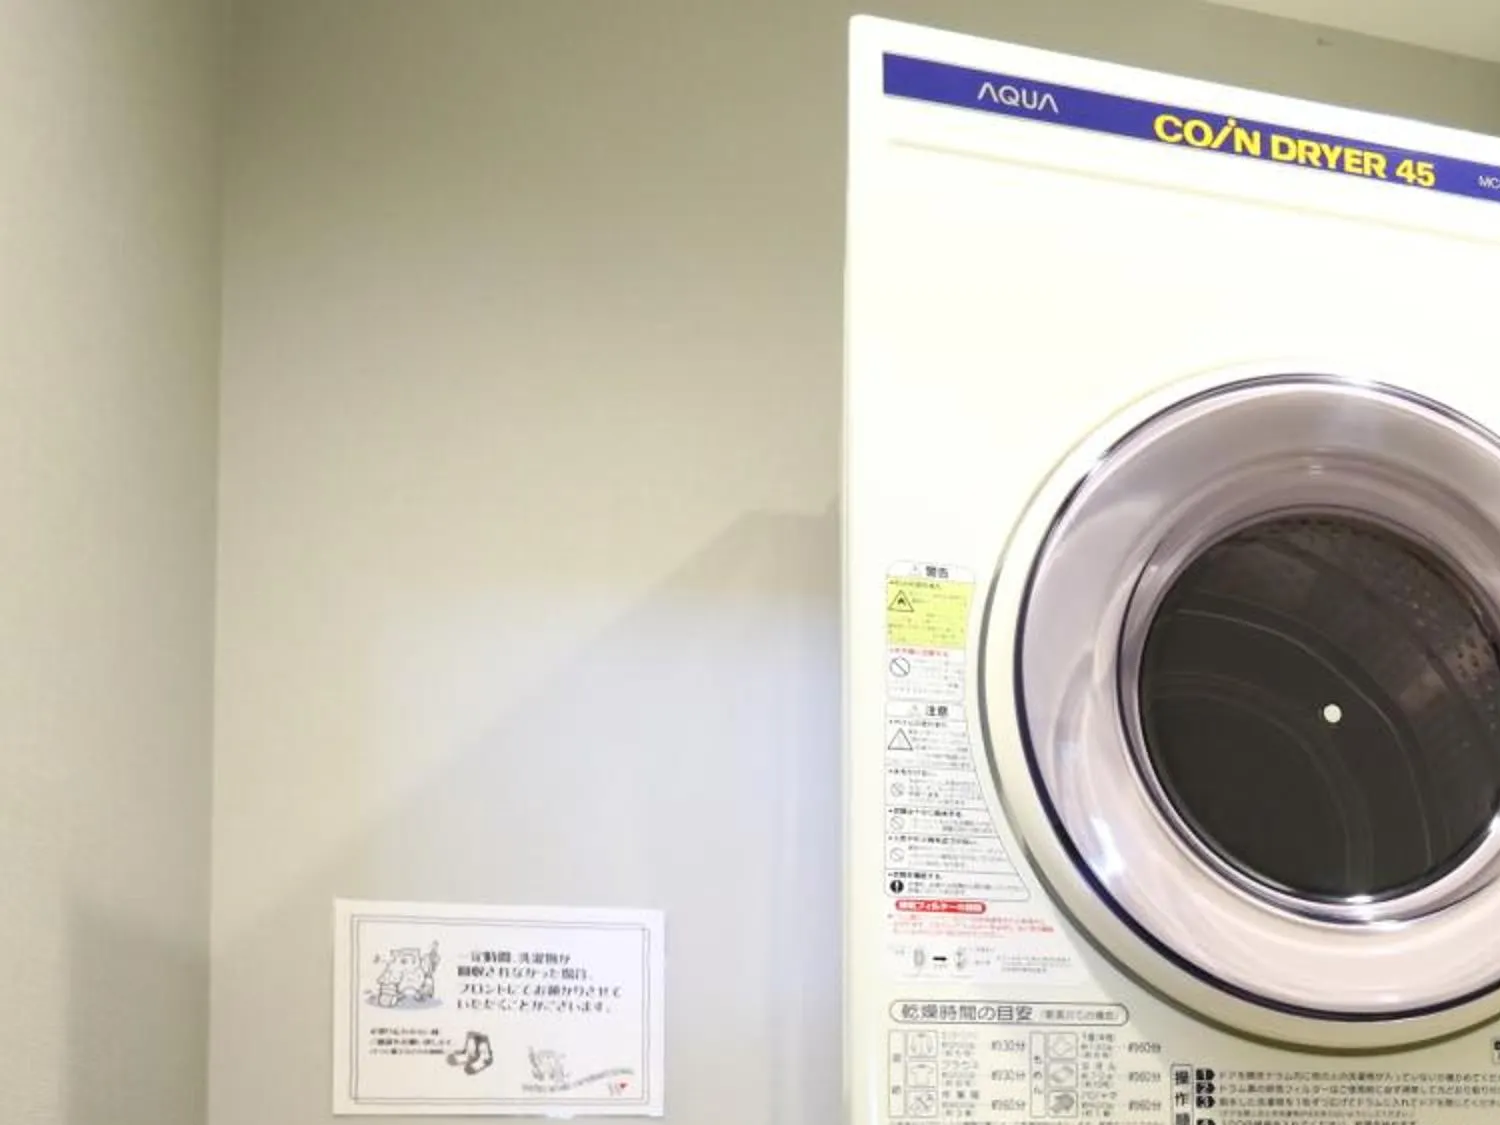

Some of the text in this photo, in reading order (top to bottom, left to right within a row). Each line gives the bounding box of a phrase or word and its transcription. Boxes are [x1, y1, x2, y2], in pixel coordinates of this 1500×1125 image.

[977, 81, 1060, 114] AQUA
[1154, 113, 1436, 188] COIN DRYER 45
[902, 1003, 1033, 1021] 乾燥時間の目安
